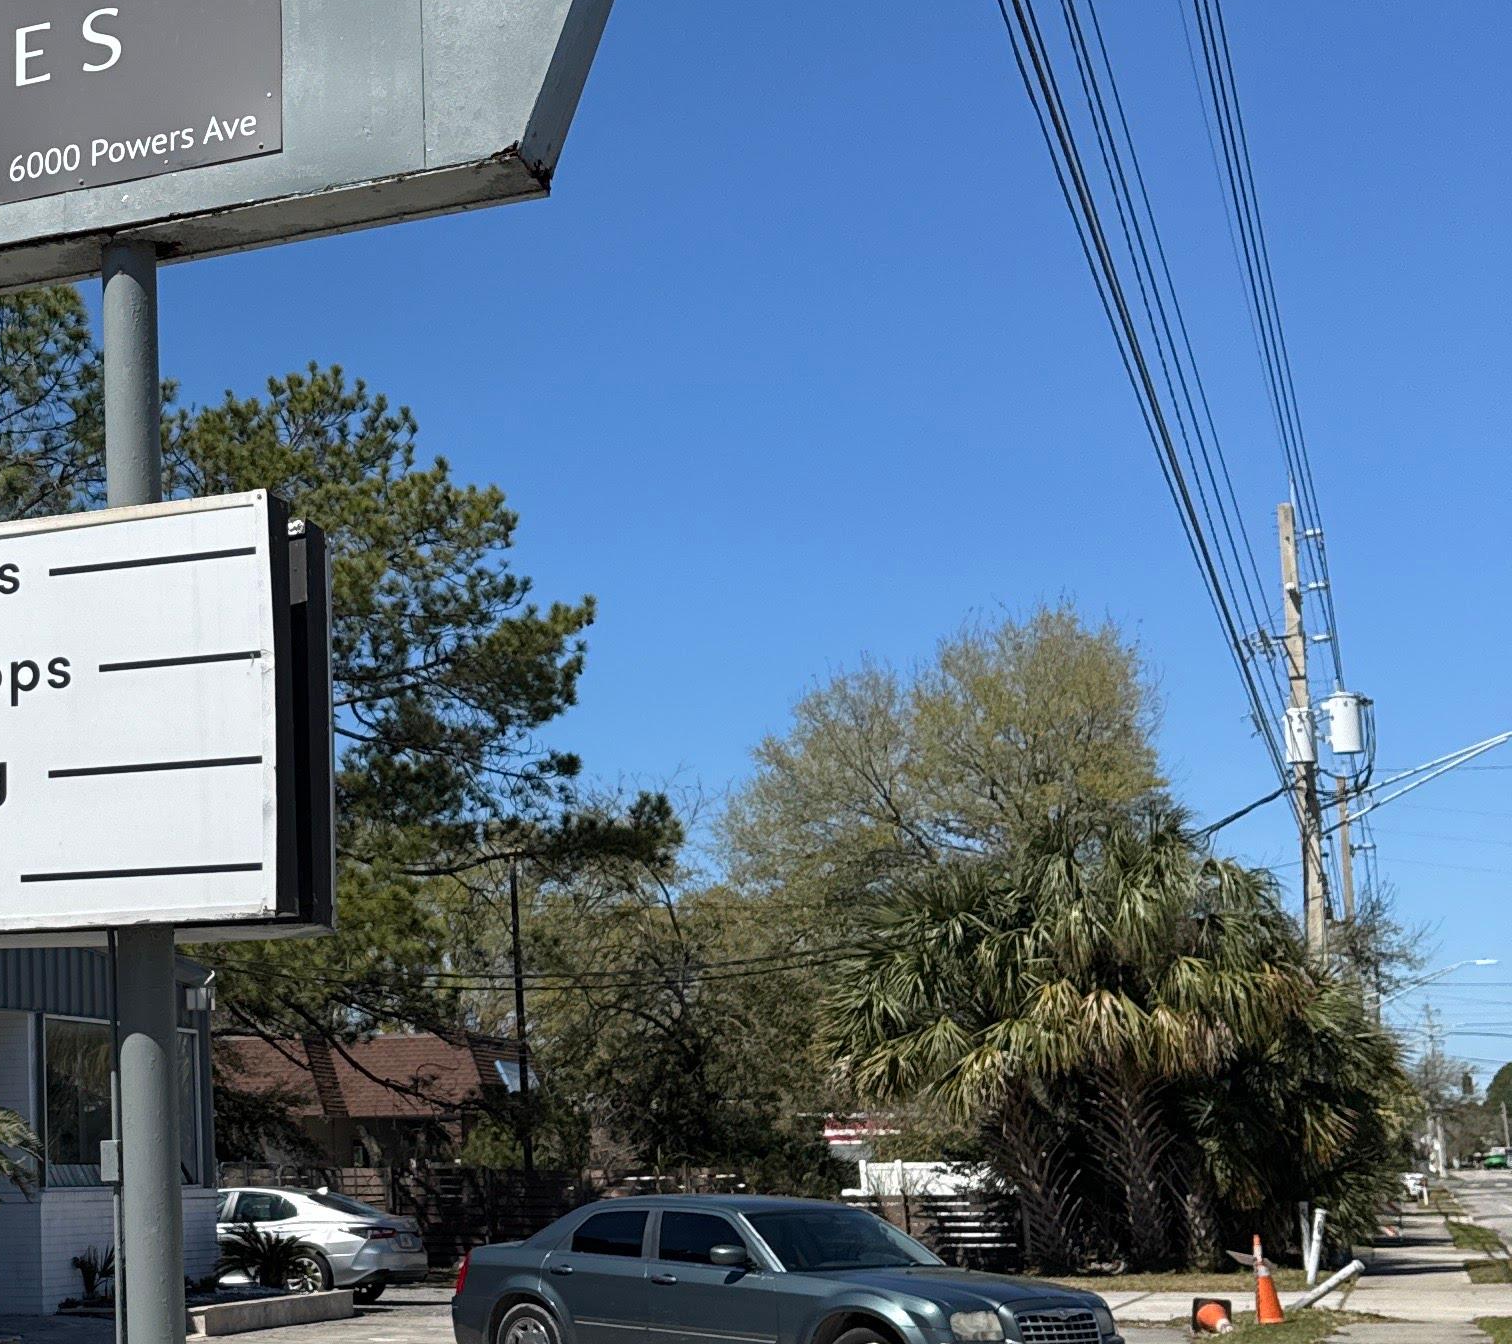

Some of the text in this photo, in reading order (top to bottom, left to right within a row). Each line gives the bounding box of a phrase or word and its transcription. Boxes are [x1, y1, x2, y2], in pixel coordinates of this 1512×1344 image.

[9, 115, 257, 182] 6000 Powers Ave
